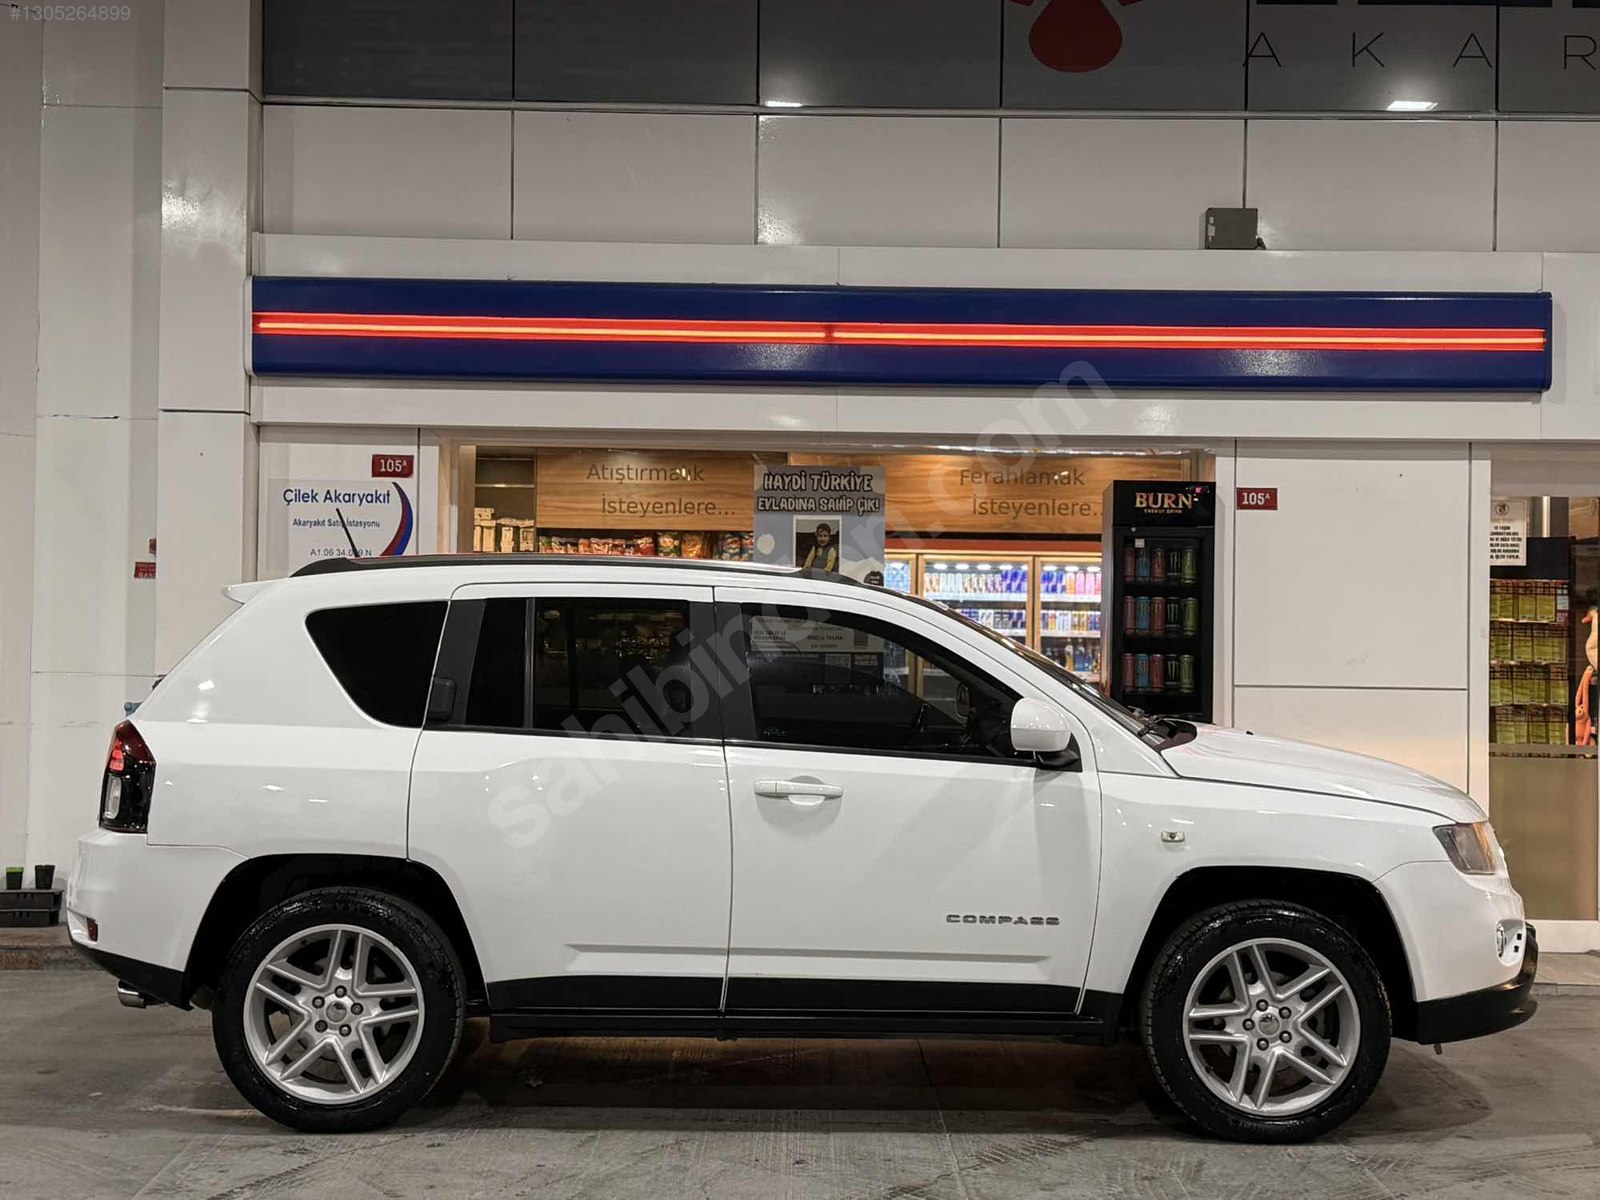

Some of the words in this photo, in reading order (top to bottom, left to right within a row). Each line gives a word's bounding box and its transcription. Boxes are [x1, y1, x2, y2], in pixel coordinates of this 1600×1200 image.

[763, 470, 807, 492] HAYDİ
[810, 470, 873, 492] TÜRKİYE
[960, 468, 1085, 486] Ferahlamak
[283, 489, 319, 506] Çilek
[323, 489, 391, 507] Akaryakıt
[757, 495, 816, 512] EVLADINA
[819, 494, 854, 513] SAHİP
[857, 496, 880, 517] ÇIK!
[1135, 492, 1193, 509] BURN
[292, 518, 326, 529] Akaryakıt
[347, 516, 381, 529] İstasyonu
[946, 914, 1060, 926] COMPASS
